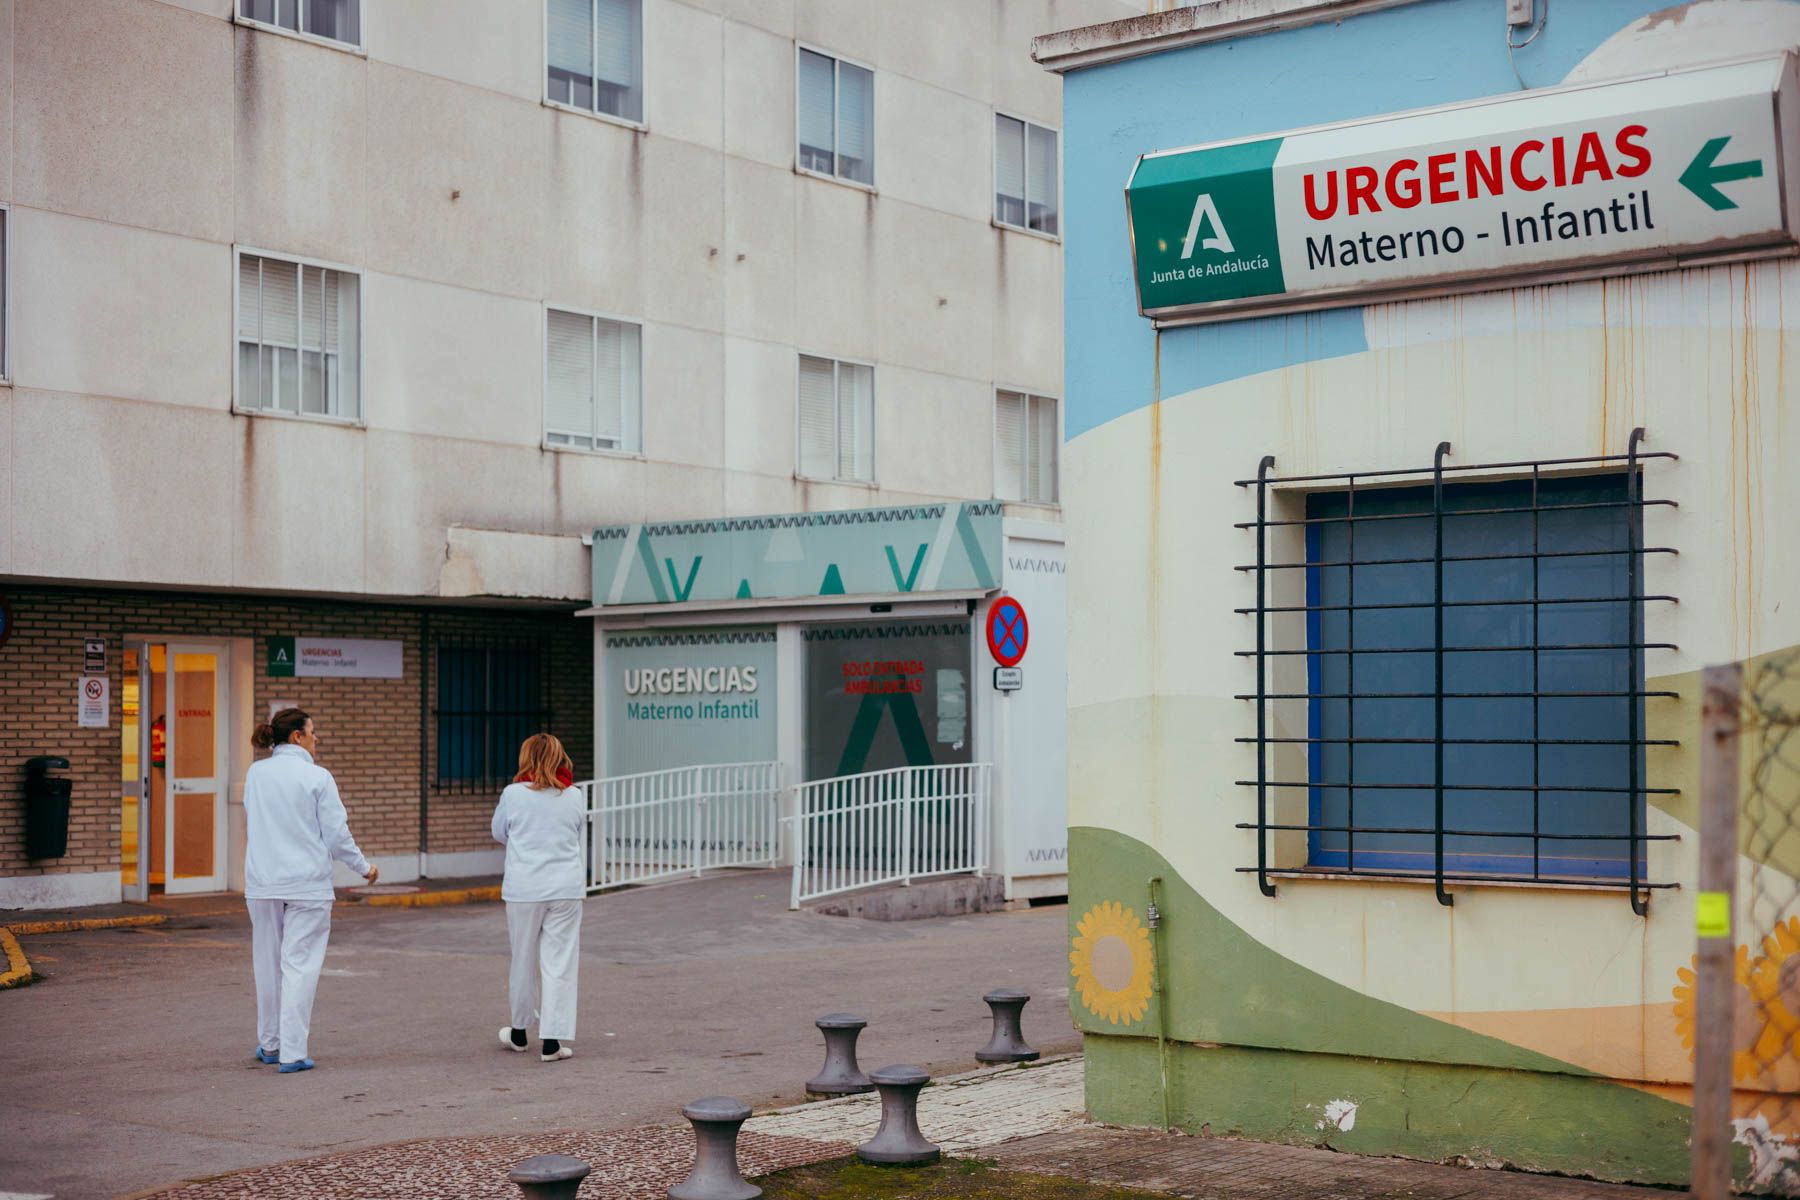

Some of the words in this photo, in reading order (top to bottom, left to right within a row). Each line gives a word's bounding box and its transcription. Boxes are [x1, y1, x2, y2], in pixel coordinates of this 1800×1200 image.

[1303, 124, 1652, 221] URGENCIAS
[1306, 224, 1465, 270] Materno
[1501, 189, 1655, 247] Infantil
[1150, 269, 1185, 284] Junta
[1187, 265, 1203, 278] de
[1206, 254, 1269, 276] Andalucía
[301, 647, 342, 657] URGENCIAS
[842, 661, 871, 677] SOLO
[873, 659, 925, 675] ENTRADA
[624, 665, 758, 695] URGENCIAS
[844, 678, 922, 695] AMBULANCIAS
[178, 709, 211, 717] ENTRADA
[627, 701, 694, 720] Materno
[698, 699, 759, 719] Infantil
